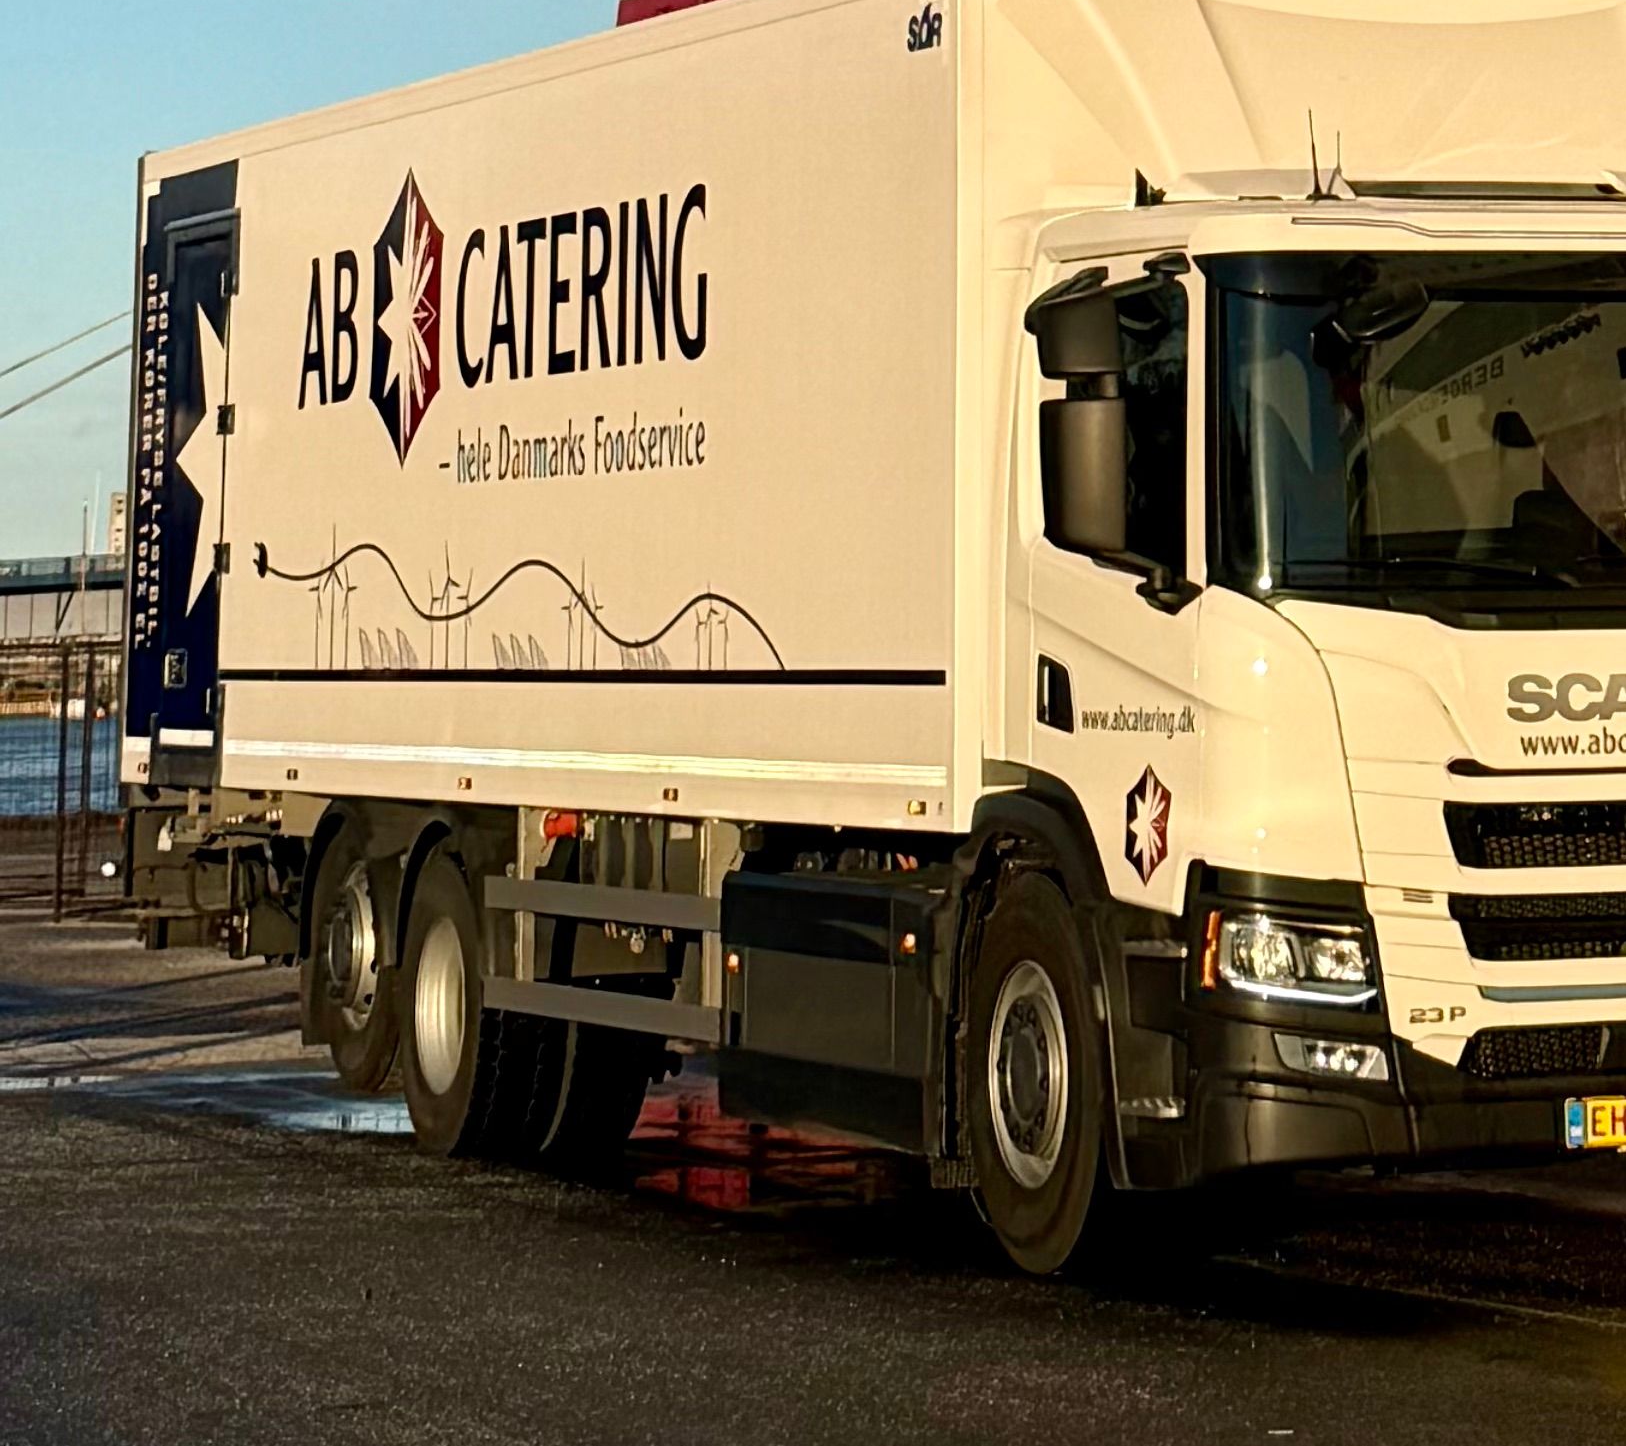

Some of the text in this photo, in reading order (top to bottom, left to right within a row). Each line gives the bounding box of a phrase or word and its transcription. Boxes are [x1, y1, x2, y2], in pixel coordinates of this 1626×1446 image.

[297, 182, 709, 411] AB CATERING
[456, 427, 492, 484] hele
[498, 418, 586, 481] Danmarks
[593, 407, 707, 476] Foodservice
[1081, 704, 1196, 740] www.abcatering.dk
